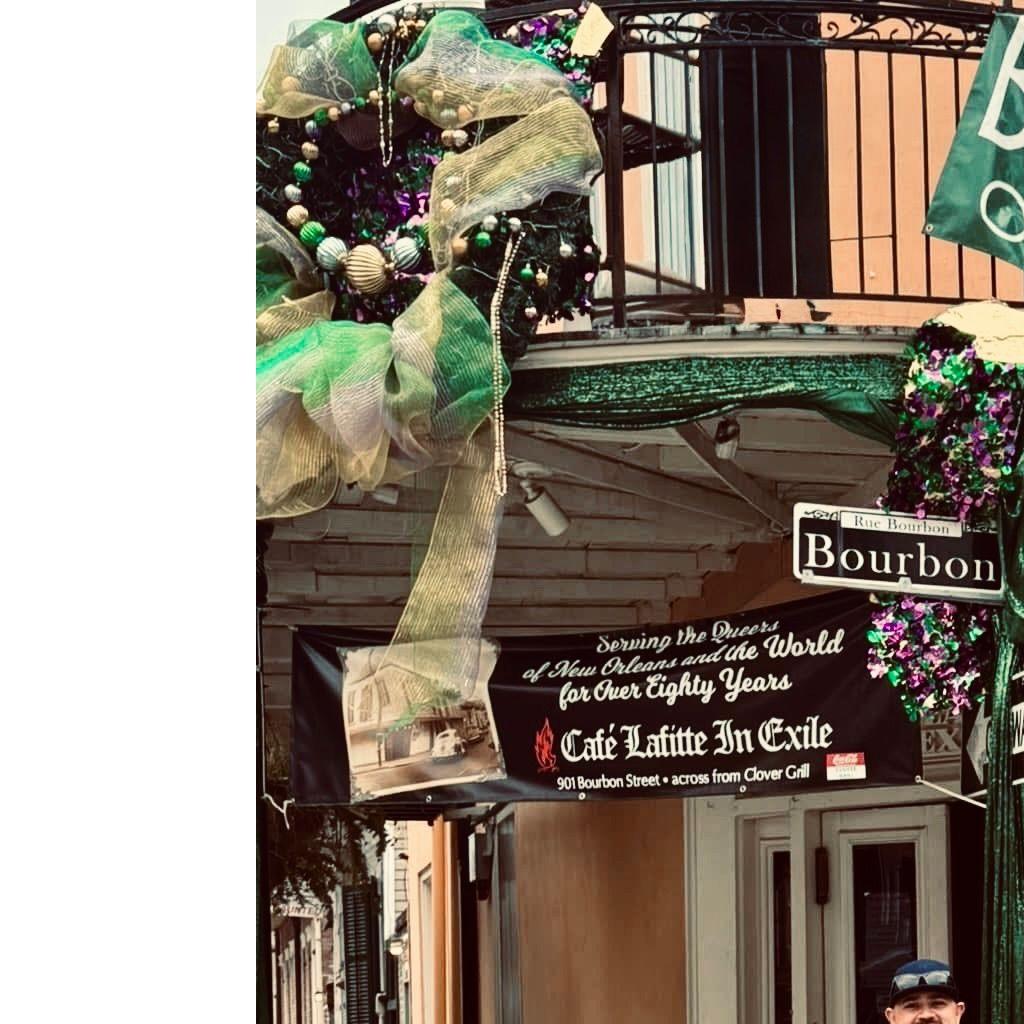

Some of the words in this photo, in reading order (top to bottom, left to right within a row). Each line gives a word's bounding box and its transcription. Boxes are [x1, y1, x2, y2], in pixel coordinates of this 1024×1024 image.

[854, 515, 881, 529] Rue
[887, 518, 950, 535] Bourbon
[803, 532, 996, 583] Bourbon
[522, 662, 547, 683] of
[548, 659, 598, 680] New
[600, 654, 678, 678] Orleans
[681, 644, 723, 666] and
[724, 640, 759, 663] the
[763, 628, 846, 658] World
[596, 631, 672, 656] Serving
[676, 625, 707, 646] the
[711, 619, 780, 643] Queers
[558, 681, 591, 711] for
[593, 679, 642, 702] Over
[646, 674, 716, 706] Eighty
[719, 667, 793, 702] Years
[560, 723, 619, 763] Café
[620, 722, 708, 761] Lafitte
[712, 718, 753, 756] In
[757, 714, 834, 753] Exile
[557, 776, 576, 790] 901
[577, 774, 625, 790] Bourbon
[626, 773, 661, 787] Street
[671, 771, 709, 786] across
[712, 768, 741, 784] from
[744, 766, 783, 782] Clover
[785, 763, 810, 780] Grill
